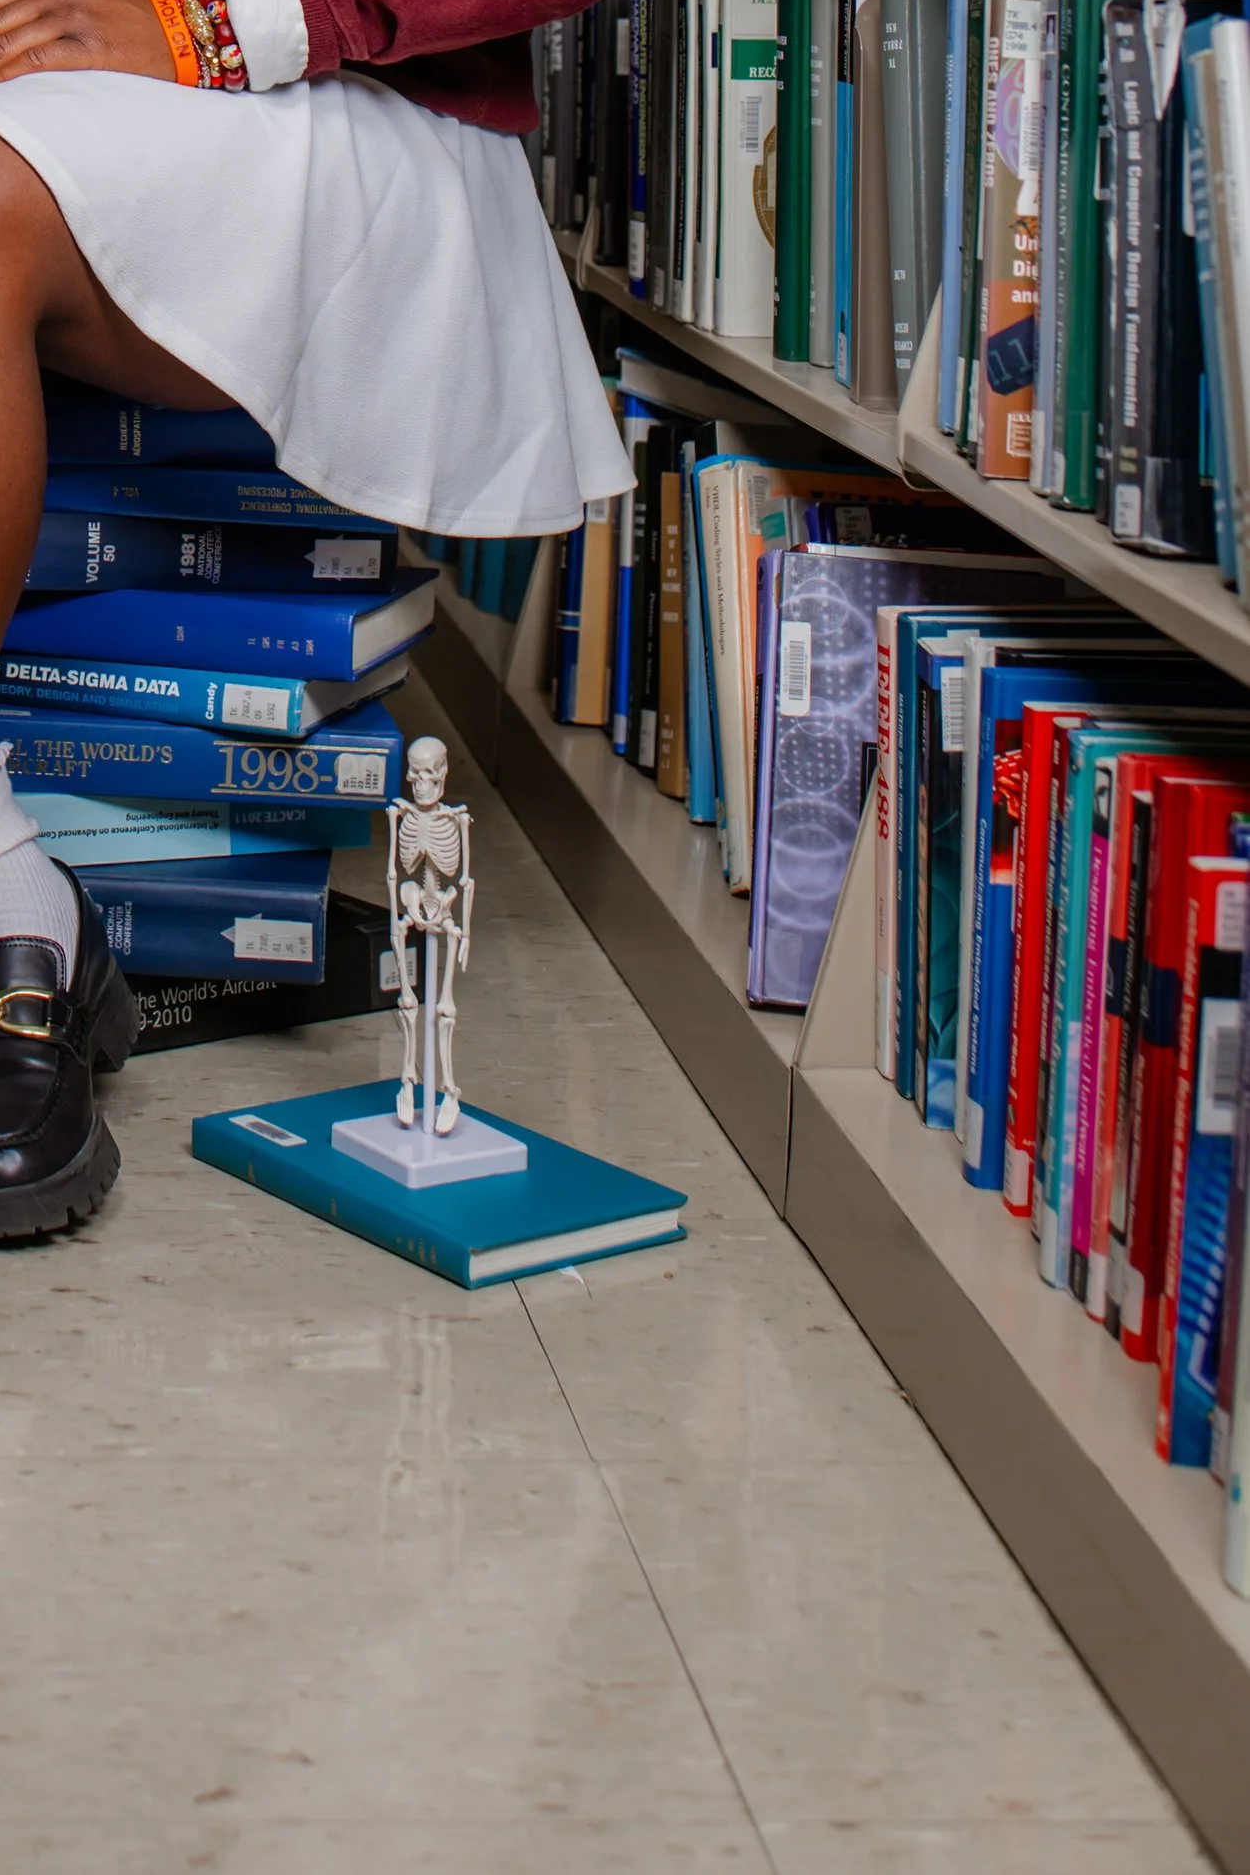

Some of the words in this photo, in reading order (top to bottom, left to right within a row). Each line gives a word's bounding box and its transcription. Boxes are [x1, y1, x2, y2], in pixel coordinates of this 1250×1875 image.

[1007, 10, 1019, 19] TK
[989, 37, 1000, 82] ONES
[1005, 42, 1028, 52] 1998
[986, 90, 998, 125] AND
[1123, 80, 1139, 123] Logic
[638, 78, 647, 176] ENGINEERING
[1125, 126, 1140, 159] and
[984, 129, 996, 188] ZEROS
[1057, 63, 1073, 239] CONTEMPORARY
[1126, 164, 1141, 247] Computer
[1124, 251, 1138, 308] Design
[1122, 312, 1138, 427] Fundamentals
[237, 485, 287, 498] PROCESSING
[240, 500, 293, 513] CONFERENCE
[712, 485, 720, 514] VHDL
[86, 522, 101, 583] VOLUME
[713, 515, 721, 547] Coding
[103, 544, 116, 562] 50
[180, 533, 196, 576] 1981
[196, 534, 206, 576] NATIONAL
[205, 530, 213, 579] COMPUTER
[212, 525, 222, 584] CONFERENCE
[319, 565, 327, 575] TK
[714, 547, 723, 574] Styles
[717, 593, 726, 655] Methodologies
[6, 663, 128, 691] DELTA-SIGMA
[134, 677, 180, 697] DATA
[36, 687, 79, 703] DESIGN
[81, 691, 106, 706] AND
[108, 695, 179, 713] SIMULATION
[205, 682, 218, 720] Candy
[230, 707, 238, 717] TK
[266, 702, 276, 722] 1992
[897, 693, 905, 747] MASTERING
[34, 740, 75, 759] THE
[81, 741, 174, 764] WORLD'S
[877, 641, 891, 841] IEEE-488
[217, 746, 342, 794] 1998-
[58, 828, 97, 839] Advanced
[98, 828, 110, 836] on
[111, 824, 156, 836] Conference
[157, 822, 207, 834] International
[125, 809, 173, 823] Engineering
[174, 810, 189, 821] and
[190, 807, 219, 820] Theory
[235, 810, 261, 824] 2011
[264, 809, 306, 822] ICACTE
[1018, 770, 1030, 857] Designer's
[974, 818, 988, 931] Communicating
[1016, 861, 1026, 908] Guide
[107, 905, 116, 947] NATIONAL
[114, 905, 124, 949] COMPUTER
[123, 900, 133, 955] CONFERENCE
[1016, 912, 1024, 931] to
[1043, 864, 1056, 990] Microprocessor
[245, 940, 254, 950] TK
[1015, 933, 1023, 960] the
[972, 934, 983, 1010] Embedded
[161, 982, 217, 1006] World's
[1011, 964, 1021, 1030] Cypress
[1081, 957, 1099, 1070] Embedded
[970, 1014, 981, 1074] Systems
[1039, 993, 1050, 1060] Systems
[1009, 1033, 1019, 1079] PSoC
[1077, 1073, 1093, 1175] Hardware
